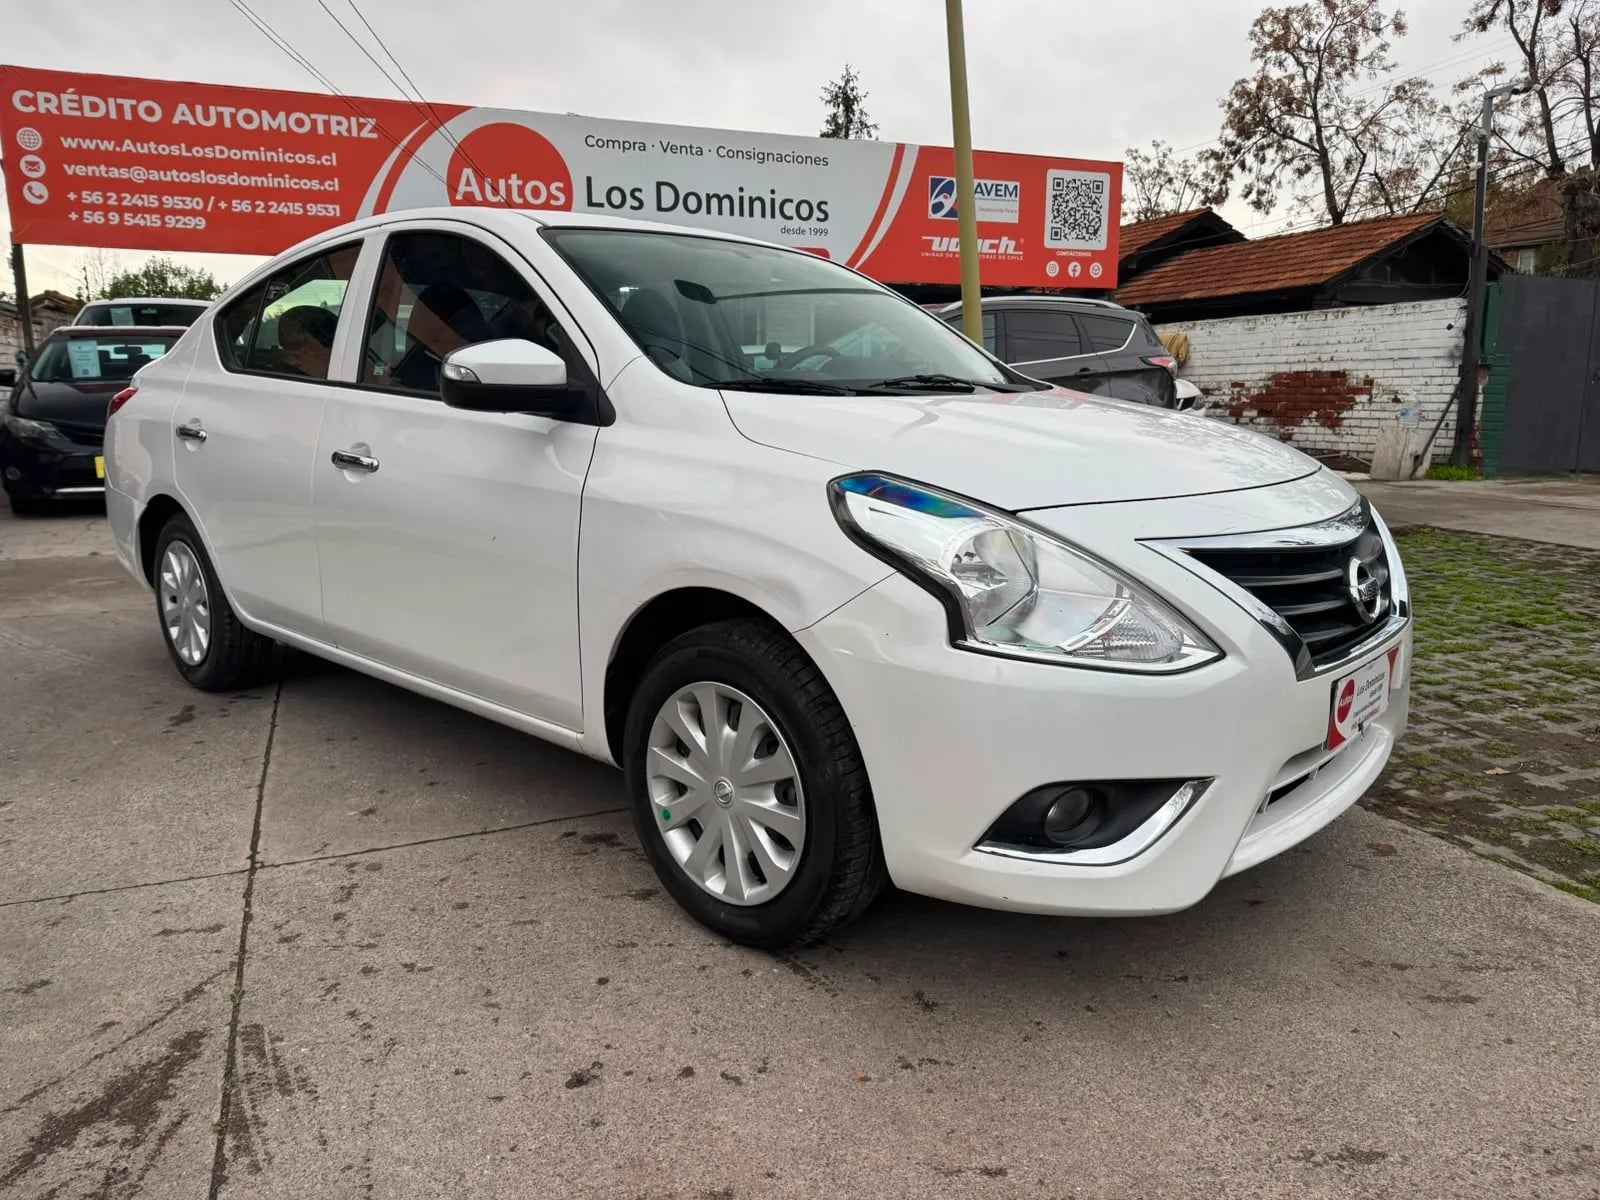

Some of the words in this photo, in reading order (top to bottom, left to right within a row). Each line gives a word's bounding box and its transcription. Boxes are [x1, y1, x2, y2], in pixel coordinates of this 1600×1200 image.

[12, 88, 163, 123] CRÉDITO
[172, 103, 379, 139] AUTOMOTRIZ
[60, 134, 337, 166] www.AutosLosDominicos.cl
[584, 134, 646, 152] Compra
[659, 140, 703, 156] Venta
[716, 145, 829, 167] Consignaciones
[63, 162, 340, 192] ventas@autoslosdominicos.cl
[455, 167, 567, 206] Autos
[82, 191, 104, 204] 56
[106, 192, 118, 205] 2
[121, 193, 159, 208] 2415
[162, 196, 204, 211] 9530
[231, 200, 252, 213] 56
[255, 201, 265, 214] 2
[268, 201, 304, 215] 2415
[306, 203, 341, 217] 9531
[586, 175, 645, 211] Los
[655, 180, 830, 222] Dominicos
[83, 211, 105, 225] 56
[108, 212, 120, 225] 9
[124, 213, 162, 227] 5415
[165, 215, 207, 229] 9299
[780, 225, 806, 236] desde
[808, 227, 829, 236] 1999
